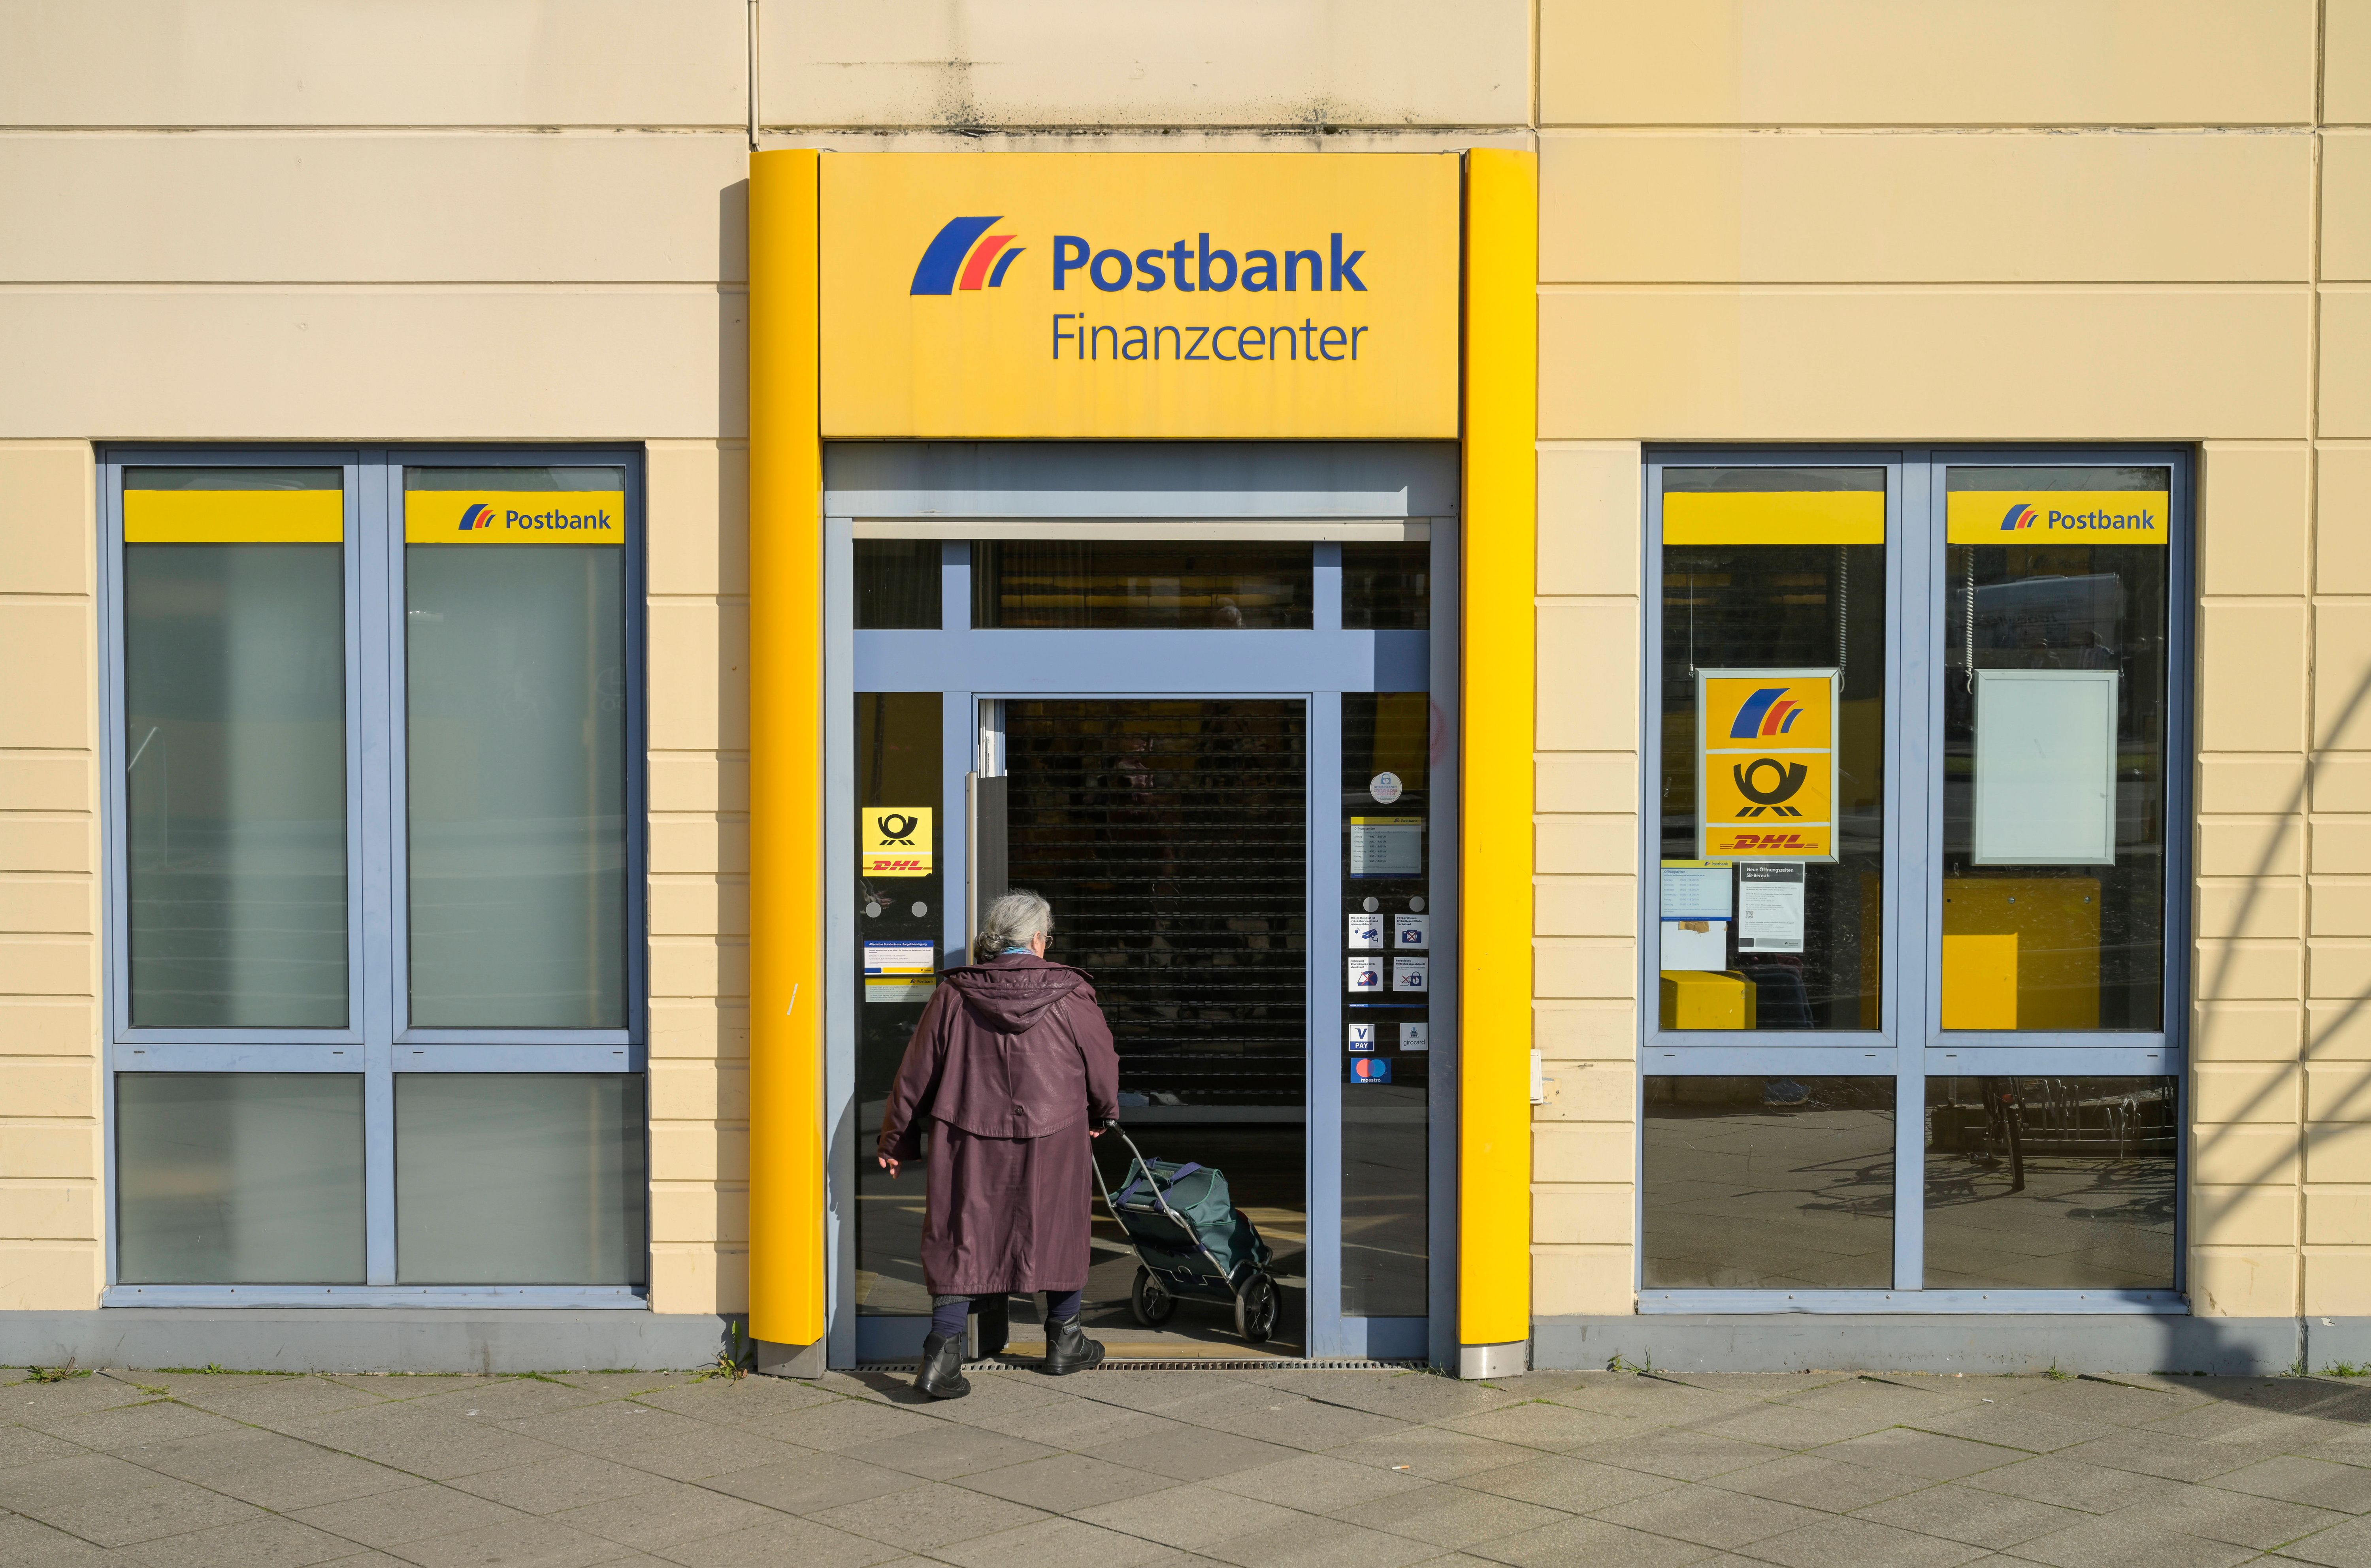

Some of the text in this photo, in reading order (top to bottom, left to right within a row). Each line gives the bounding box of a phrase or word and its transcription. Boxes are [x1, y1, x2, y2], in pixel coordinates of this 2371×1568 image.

[1053, 233, 1368, 292] Postbank
[1053, 312, 1368, 361] Finanzcenter
[506, 509, 612, 529] Postbank
[2049, 509, 2155, 529] Postbank
[1733, 834, 1806, 849] DHL
[872, 860, 923, 870] DHL
[1355, 1028, 1367, 1039] V
